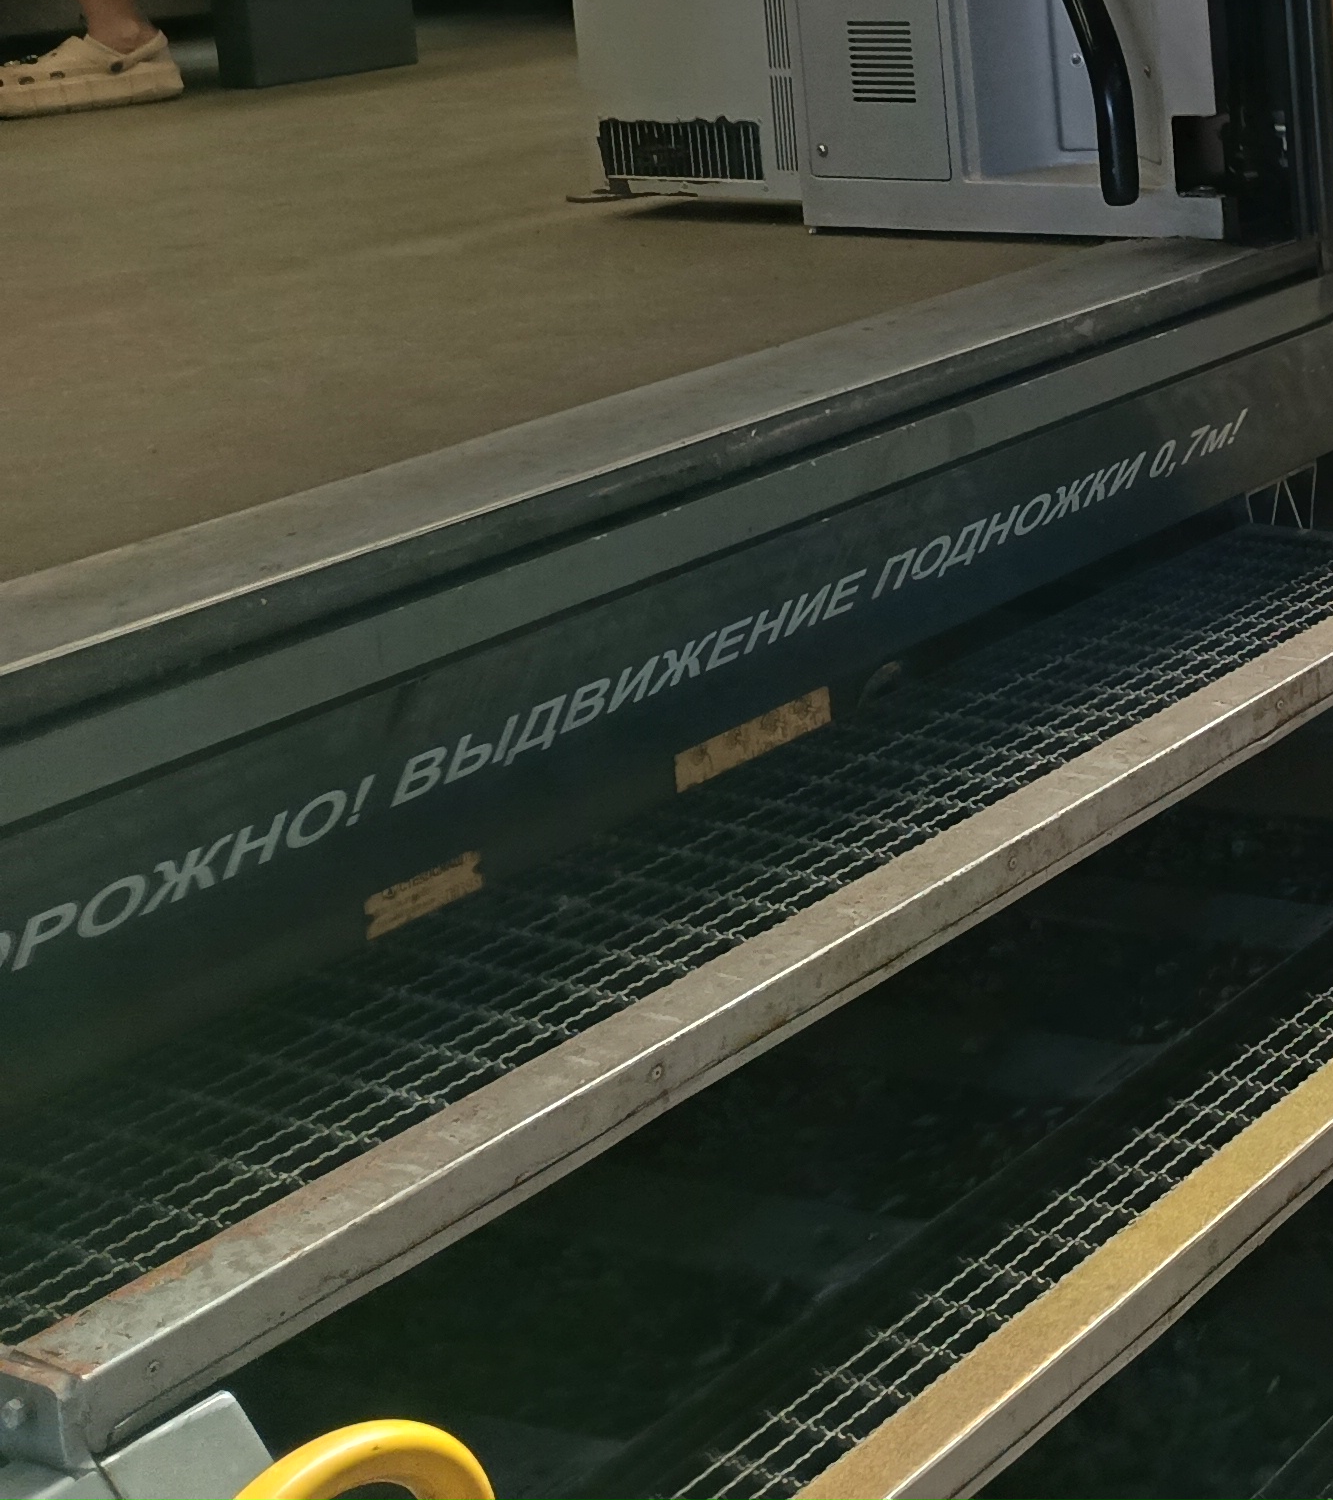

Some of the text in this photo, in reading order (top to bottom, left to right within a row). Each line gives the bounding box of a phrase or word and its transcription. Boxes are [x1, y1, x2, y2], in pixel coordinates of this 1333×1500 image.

[0, 774, 376, 972] РОЖНО!
[390, 568, 867, 808] ВЫДВИЖЕНИЕ
[871, 451, 1147, 600] ПОДНОЖКИ
